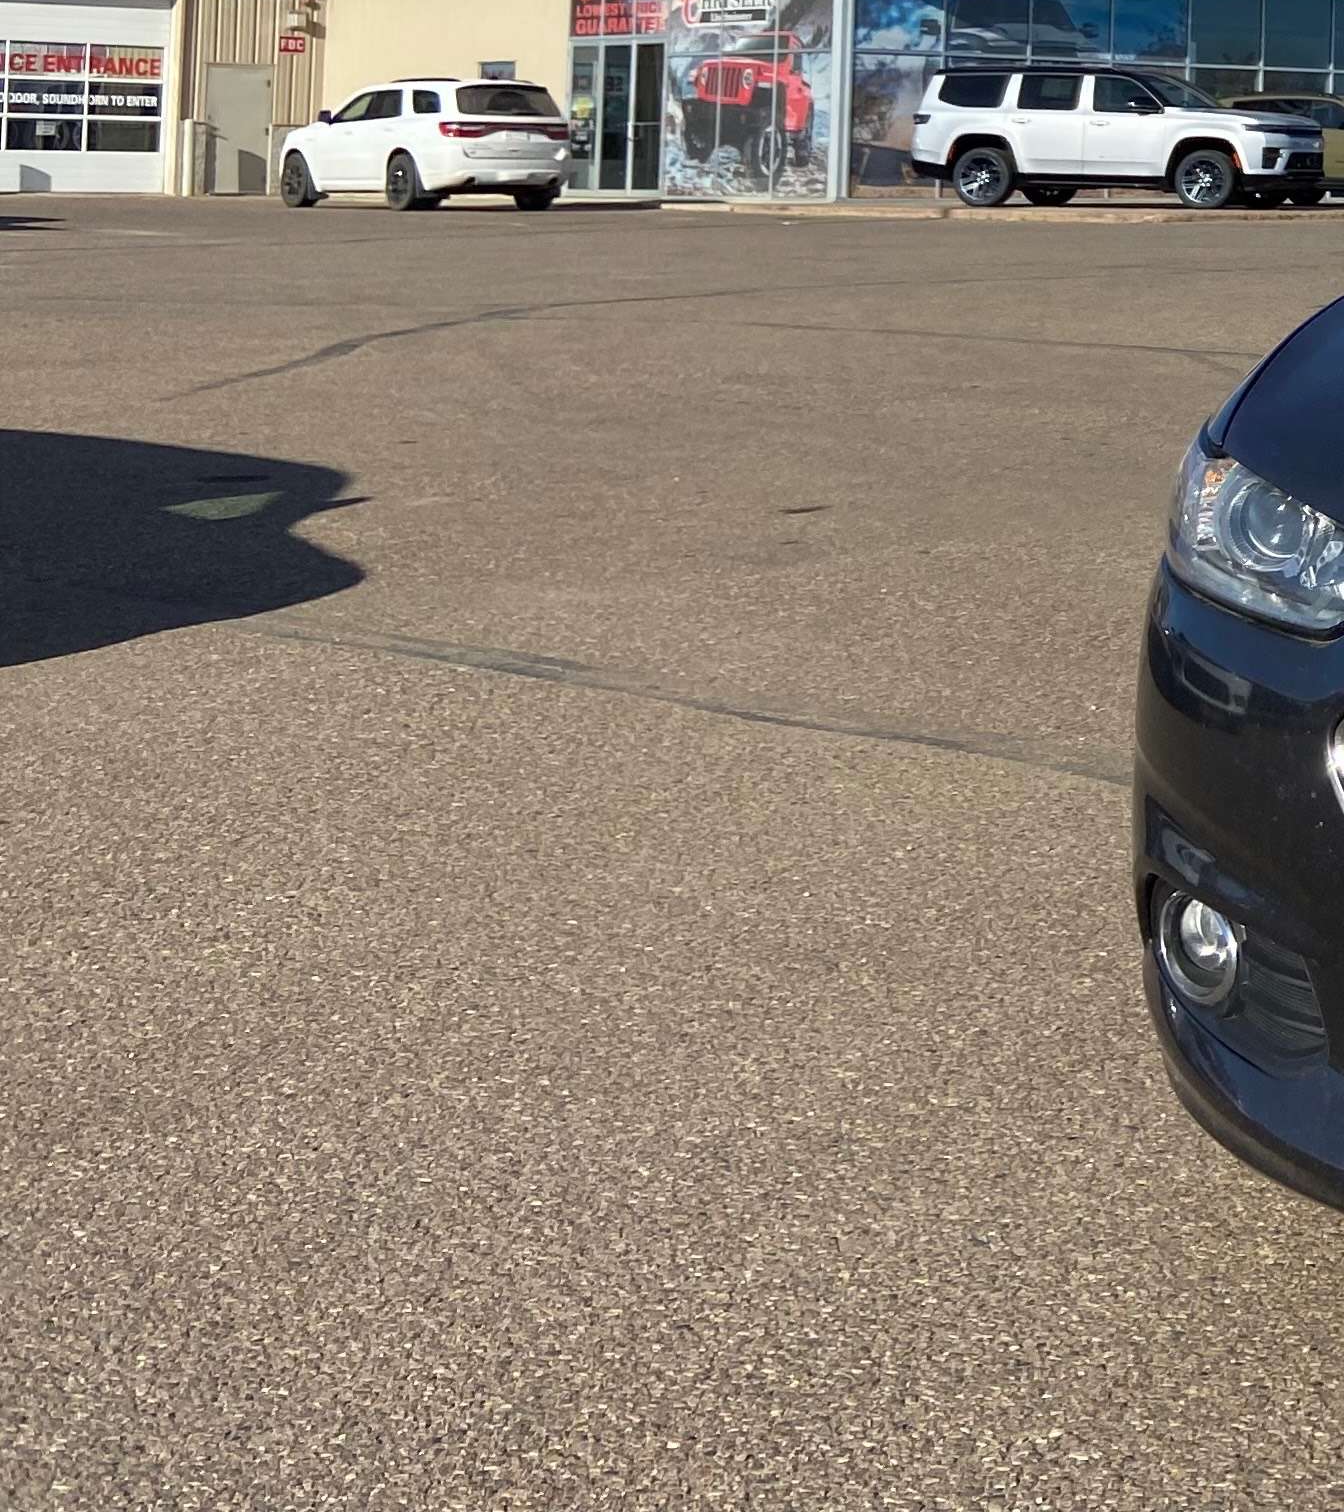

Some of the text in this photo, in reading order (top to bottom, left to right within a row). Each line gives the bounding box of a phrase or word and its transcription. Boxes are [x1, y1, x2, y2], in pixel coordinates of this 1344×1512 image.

[575, 16, 667, 34] GUARATEE
[111, 95, 125, 106] TO
[126, 95, 157, 107] ENTER
